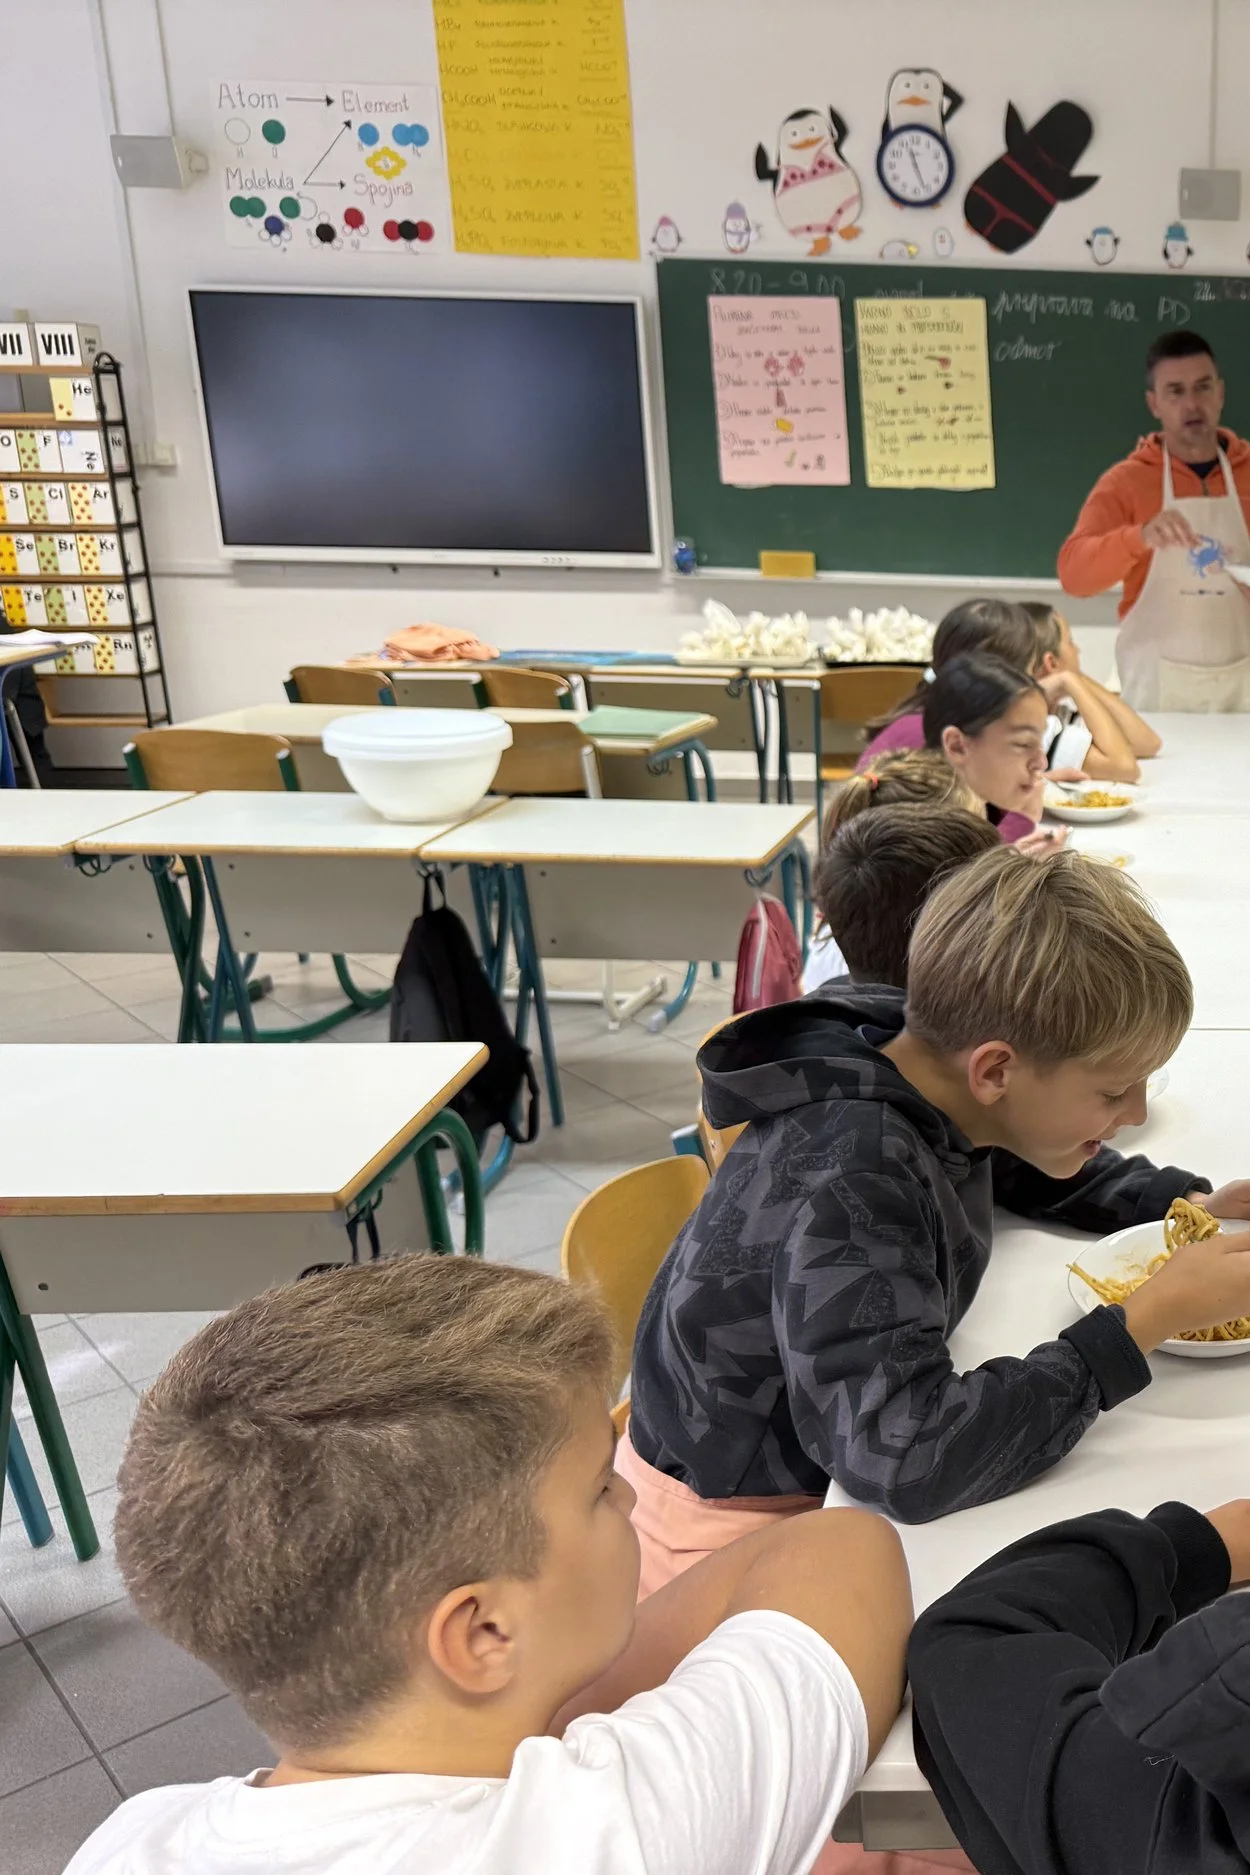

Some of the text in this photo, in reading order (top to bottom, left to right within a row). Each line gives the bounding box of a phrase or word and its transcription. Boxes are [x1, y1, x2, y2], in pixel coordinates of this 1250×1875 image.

[218, 84, 279, 109] Atom
[341, 90, 410, 113] Element
[226, 167, 295, 191] Molekula
[353, 172, 413, 208] Spojina
[41, 333, 75, 355] VIII
[71, 383, 92, 397] He
[0, 435, 12, 447] O
[9, 488, 19, 500] S
[92, 488, 109, 500] Ar
[15, 540, 115, 552] Se Br Kr
[25, 591, 42, 602] Te
[106, 590, 125, 602] Xe
[113, 639, 133, 650] Rn
